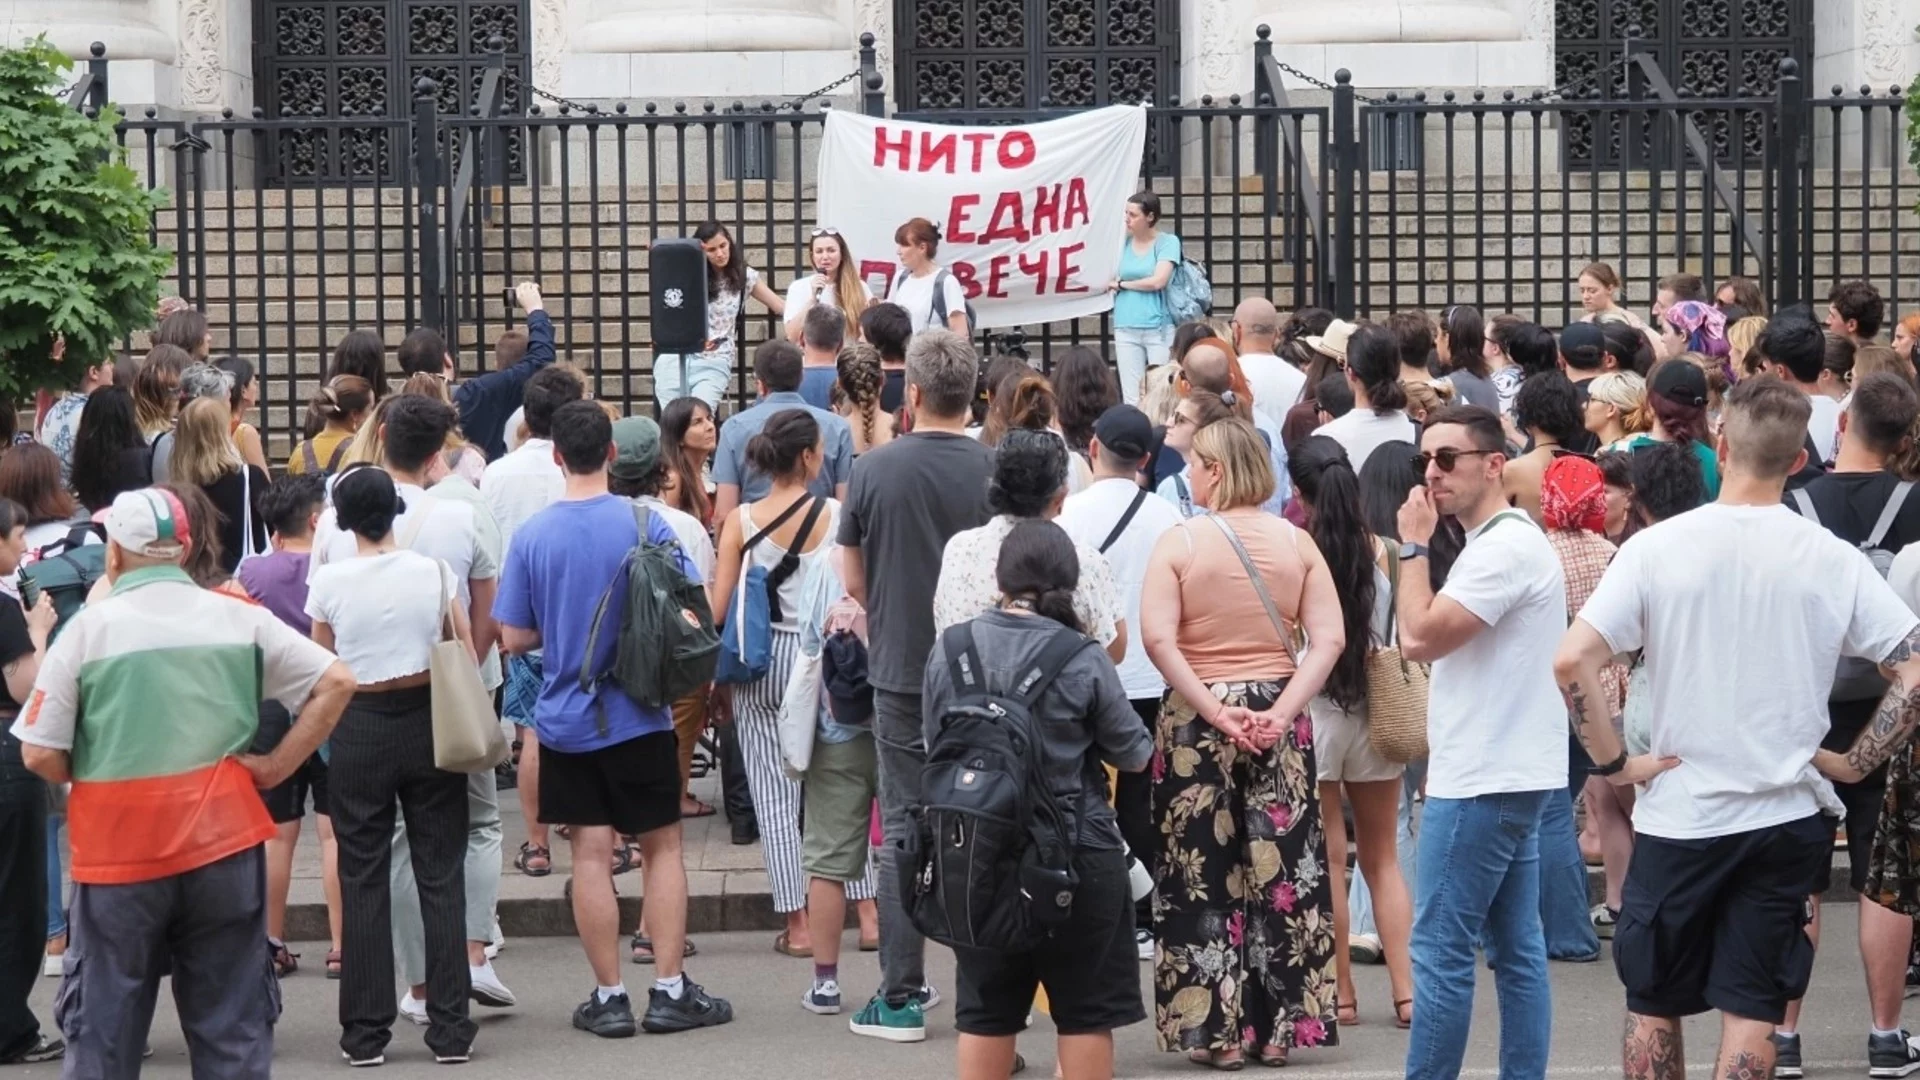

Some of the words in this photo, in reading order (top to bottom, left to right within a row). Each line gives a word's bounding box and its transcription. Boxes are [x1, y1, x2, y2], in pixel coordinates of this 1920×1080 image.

[874, 127, 1036, 173] НИТО
[947, 178, 1089, 245] ЕДНА
[861, 243, 1089, 299] ПВЕЧЕ
